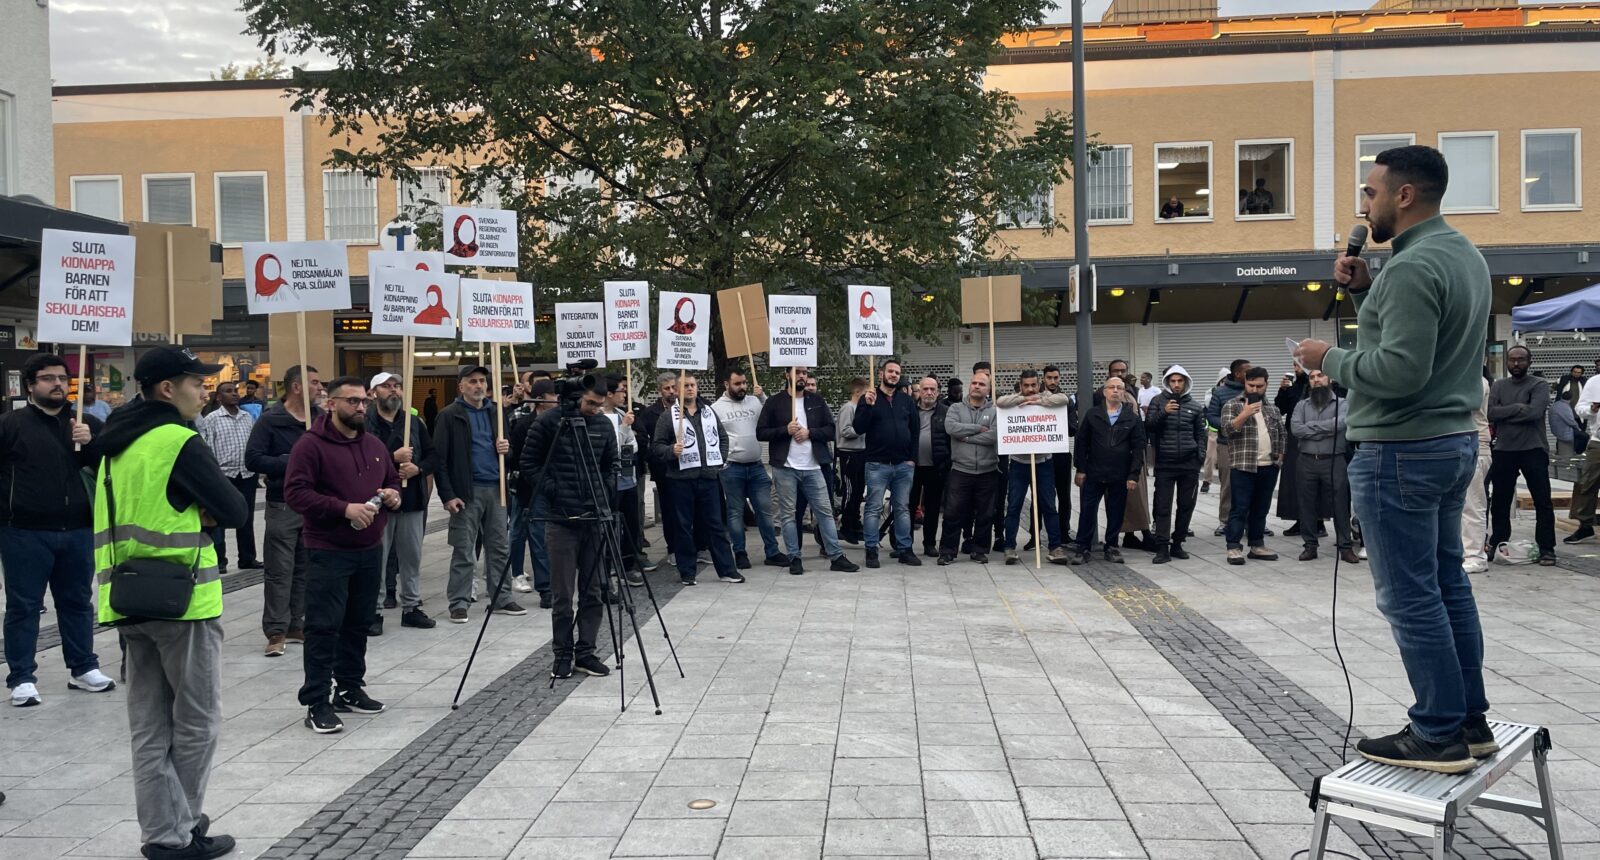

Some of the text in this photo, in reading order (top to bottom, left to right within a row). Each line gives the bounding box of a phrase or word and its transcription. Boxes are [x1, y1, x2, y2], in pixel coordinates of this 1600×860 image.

[388, 228, 411, 251] T
[72, 242, 106, 255] SLUTA
[61, 256, 115, 271] KIDNAPPA
[292, 268, 342, 279] OROSANMÄLAN
[1236, 266, 1296, 276] Databutiken
[65, 272, 109, 286] BARNEN
[310, 279, 336, 289] SLÖJAN!
[385, 284, 405, 293] NEJ TILL
[65, 286, 109, 302] FÖR ATT
[384, 294, 418, 304] KIDNAPPNING
[473, 293, 523, 304] SLUTA KIDNAPPA
[46, 302, 126, 318] SEKULARISERA
[473, 305, 523, 316] BARNEN FÖR ATT
[775, 306, 811, 315] INTEGRATION
[382, 313, 403, 322] SLÖJAN!
[72, 320, 99, 332] DEM!
[468, 318, 529, 329] SEKULARISERA DEM!
[619, 321, 628, 330] FÖR
[779, 327, 807, 335] SUDDA UT
[610, 332, 647, 341] SEKULARISERA
[623, 343, 636, 351] DEM!
[773, 338, 814, 346] MUSLIMERNAS
[780, 348, 807, 356] IDENTITET
[727, 409, 755, 419] BOSS
[1034, 424, 1045, 432] FÖR
[1002, 434, 1063, 444] SEKULARISERA DEM!
